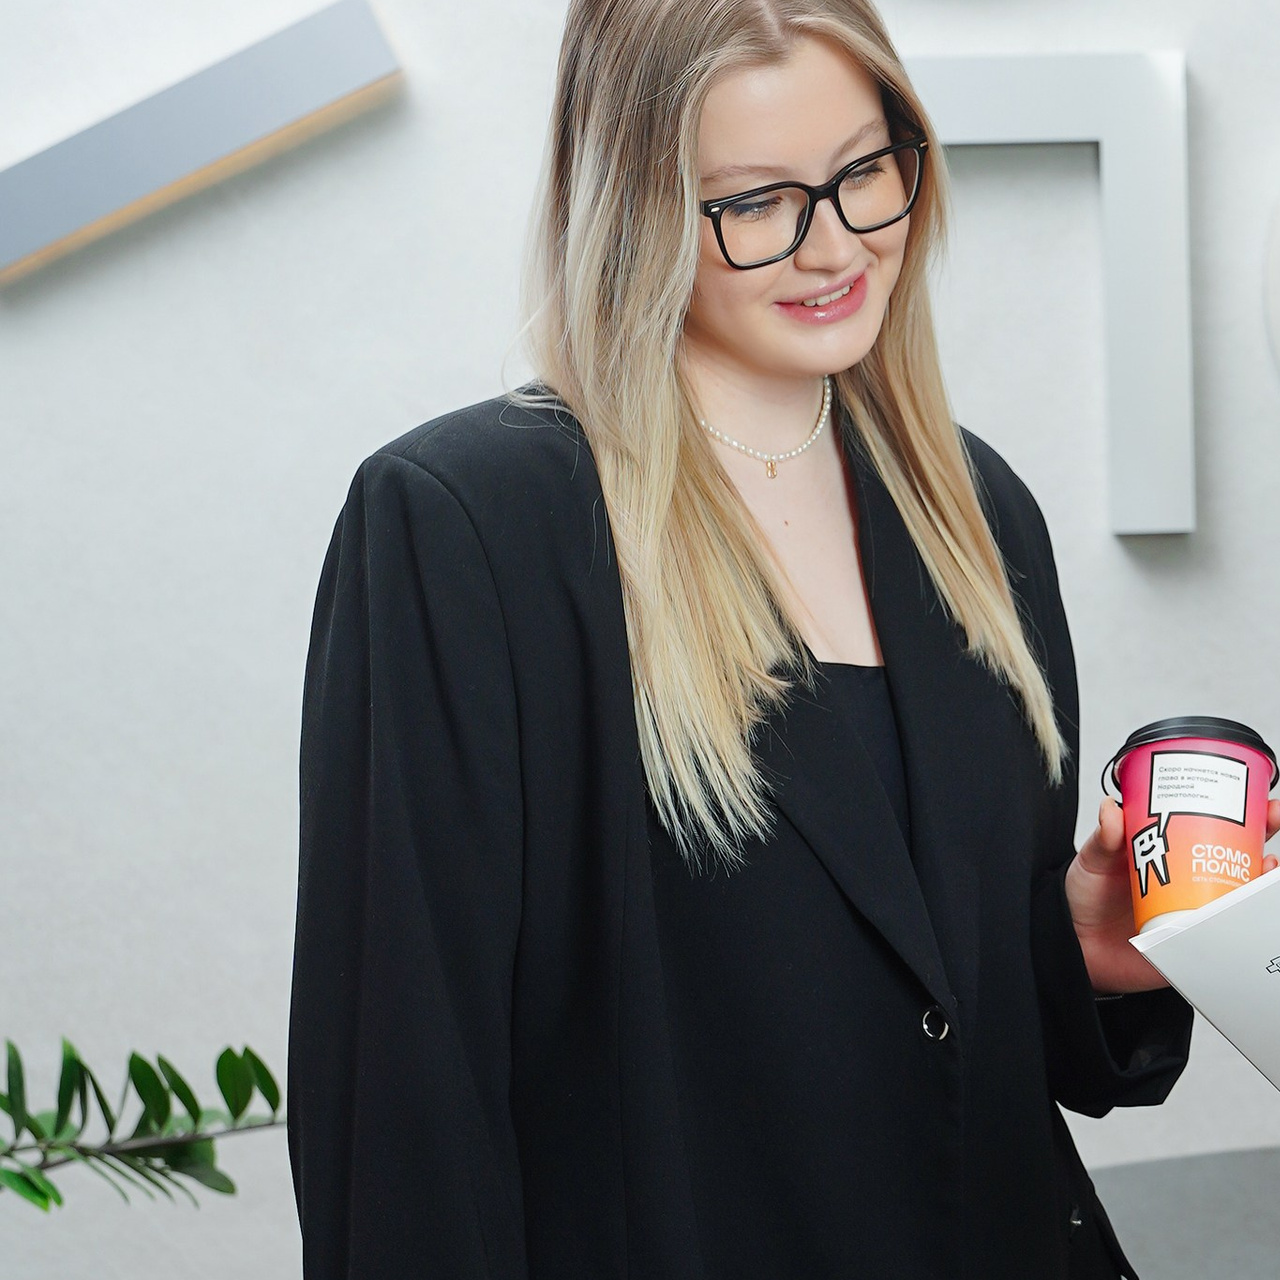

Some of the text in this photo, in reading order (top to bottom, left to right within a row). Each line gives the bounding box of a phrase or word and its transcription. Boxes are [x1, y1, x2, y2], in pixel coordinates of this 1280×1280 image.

[1159, 766, 1182, 774] Скоро
[1191, 843, 1252, 869] СТОМО
[1191, 858, 1251, 883] ПОЛИС
